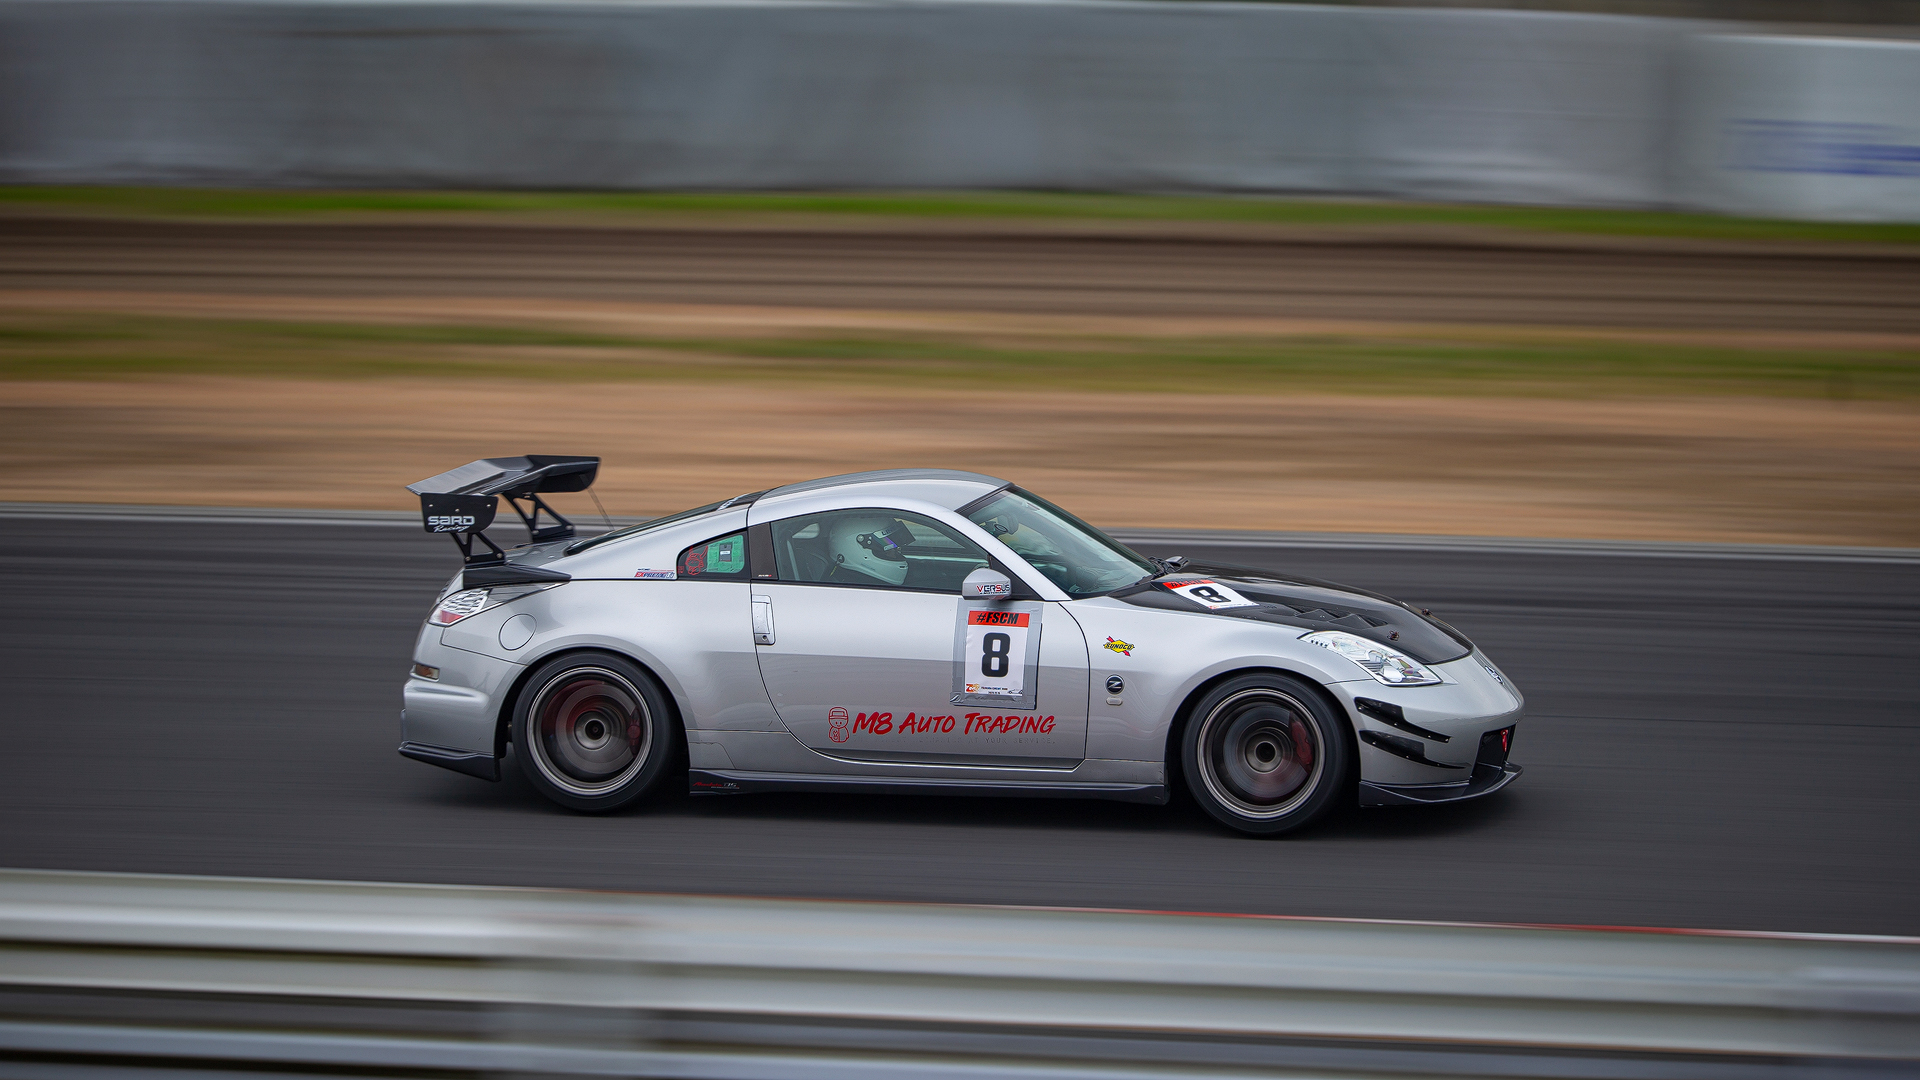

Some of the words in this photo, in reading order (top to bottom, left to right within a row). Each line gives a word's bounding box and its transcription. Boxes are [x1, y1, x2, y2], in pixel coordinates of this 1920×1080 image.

[433, 525, 470, 533] Racing
[976, 584, 1010, 593] VERSUS
[1189, 586, 1231, 603] 8
[976, 612, 1019, 625] #FSCM
[981, 632, 1011, 678] 8
[852, 711, 893, 735] M8
[898, 712, 956, 735] AUTO
[964, 712, 1057, 735] TRADING
